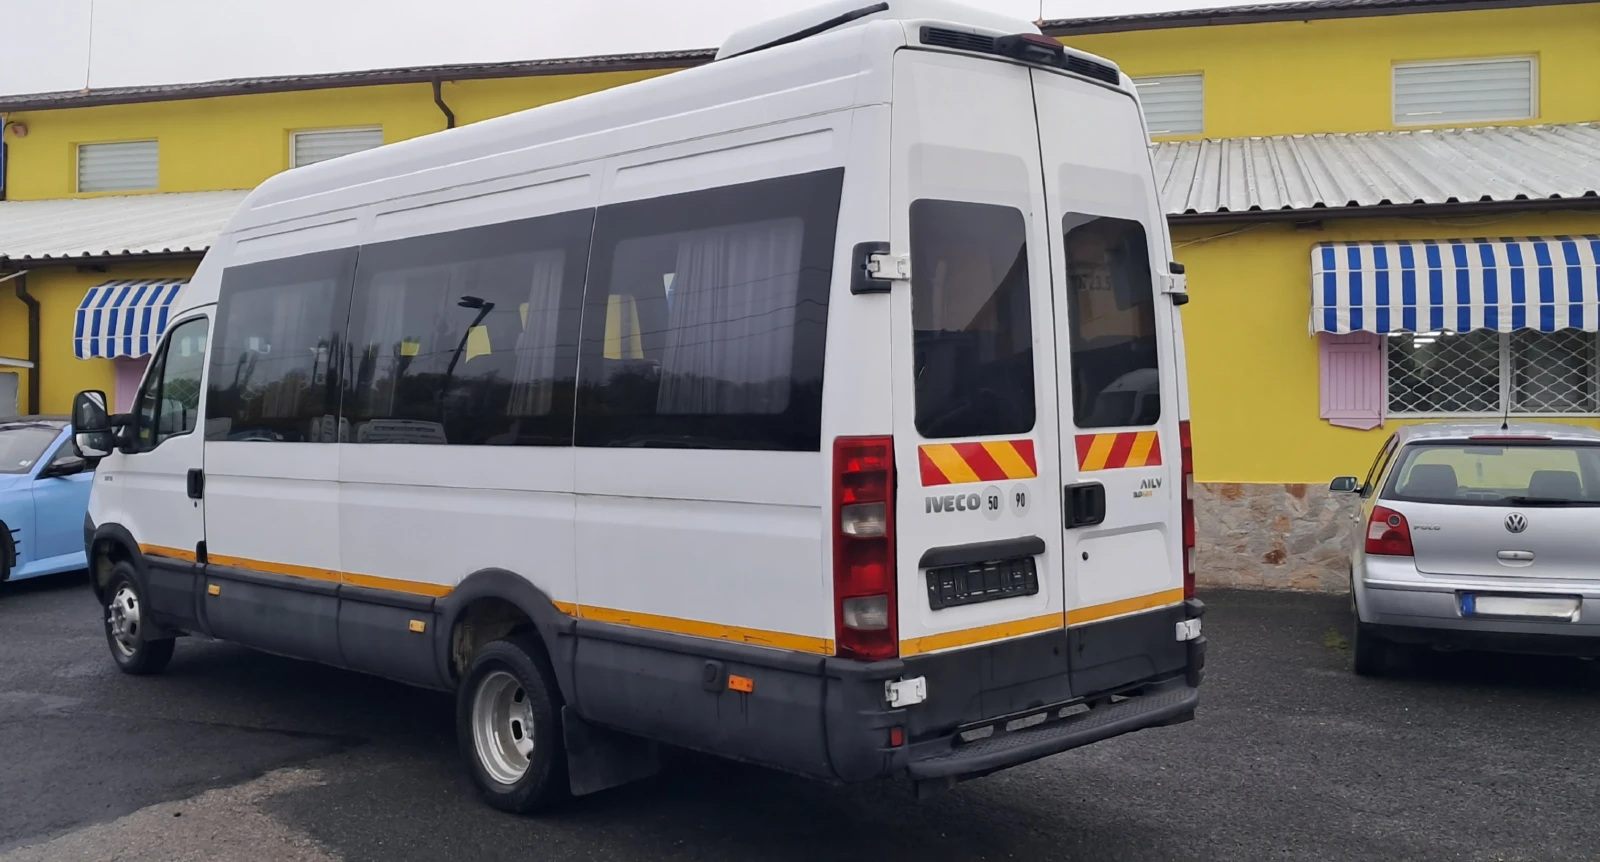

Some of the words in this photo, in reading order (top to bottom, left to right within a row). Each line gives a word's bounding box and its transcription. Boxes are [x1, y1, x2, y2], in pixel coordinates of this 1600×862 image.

[925, 493, 981, 514] IVECO
[988, 495, 999, 511] 50
[1015, 492, 1026, 508] 90
[1413, 523, 1441, 531] POLO
